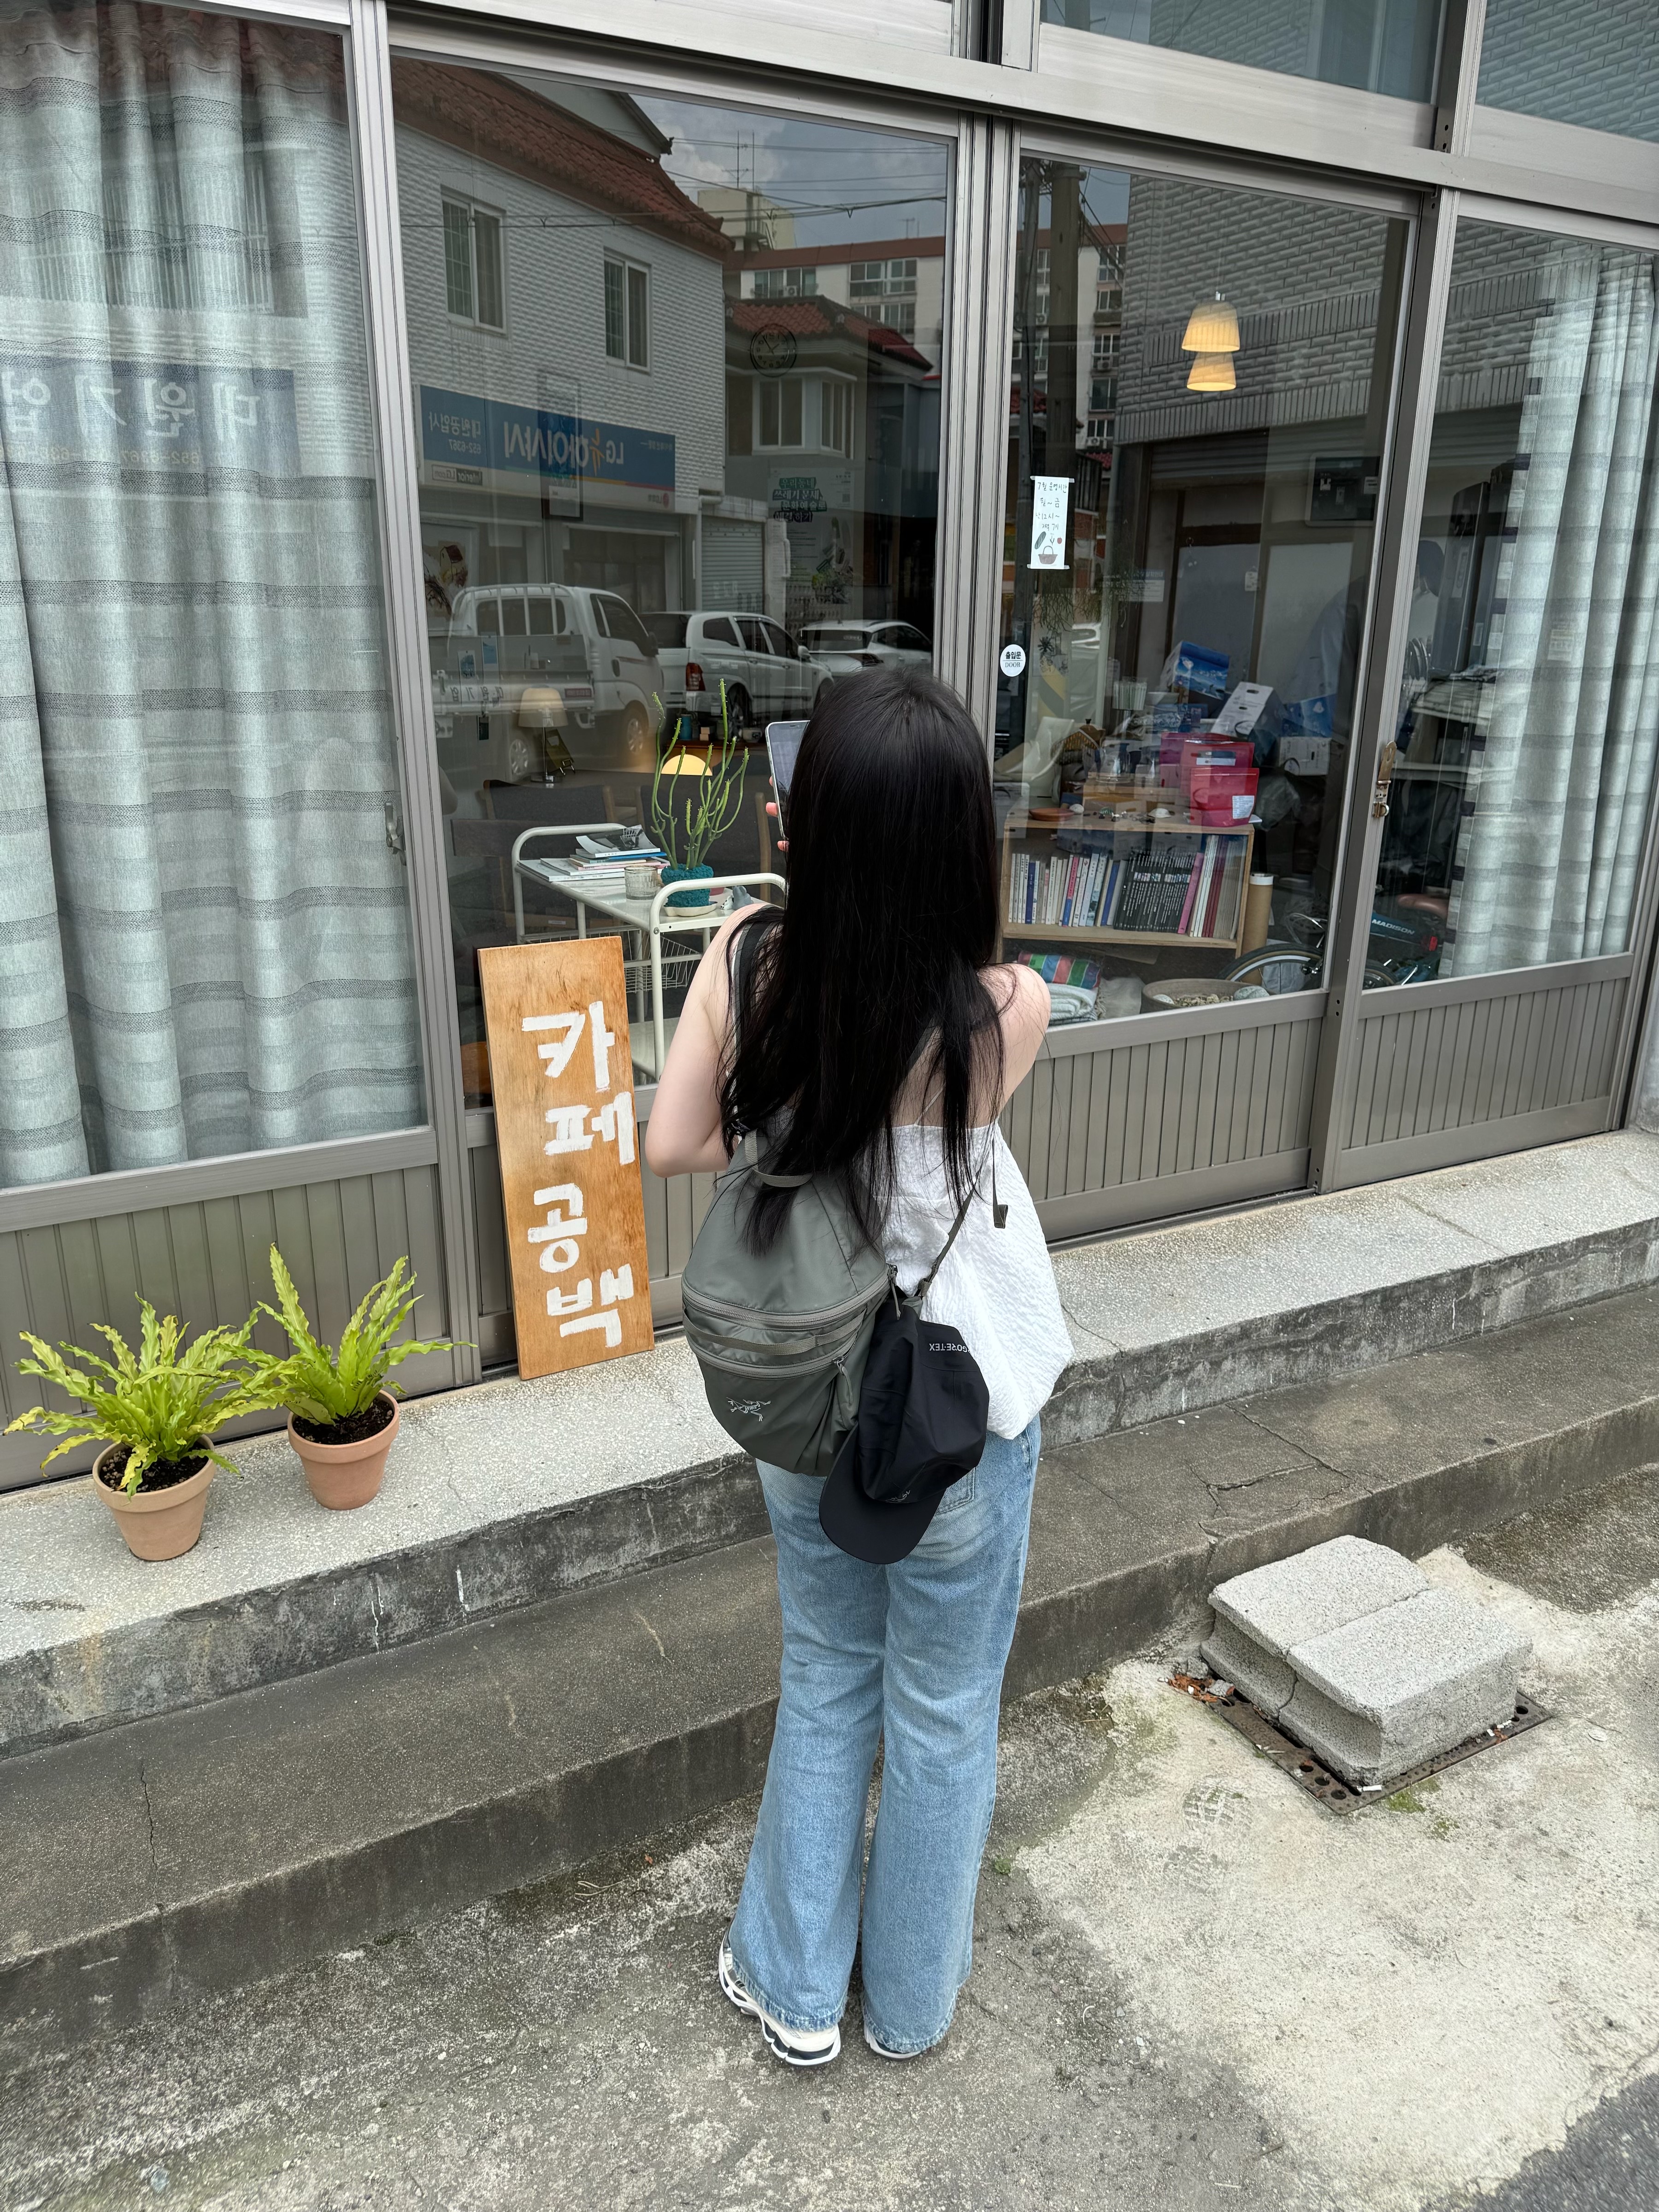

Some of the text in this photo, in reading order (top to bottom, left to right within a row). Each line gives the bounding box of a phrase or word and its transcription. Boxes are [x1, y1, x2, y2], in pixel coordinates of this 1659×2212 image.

[781, 478, 814, 488] 우리동네
[1037, 482, 1067, 493] 7월 운영시간
[774, 490, 800, 500] 쓰레기
[782, 500, 826, 511] 문화예술로
[1006, 651, 1021, 659] 출입문
[1372, 919, 1416, 935] MADISON
